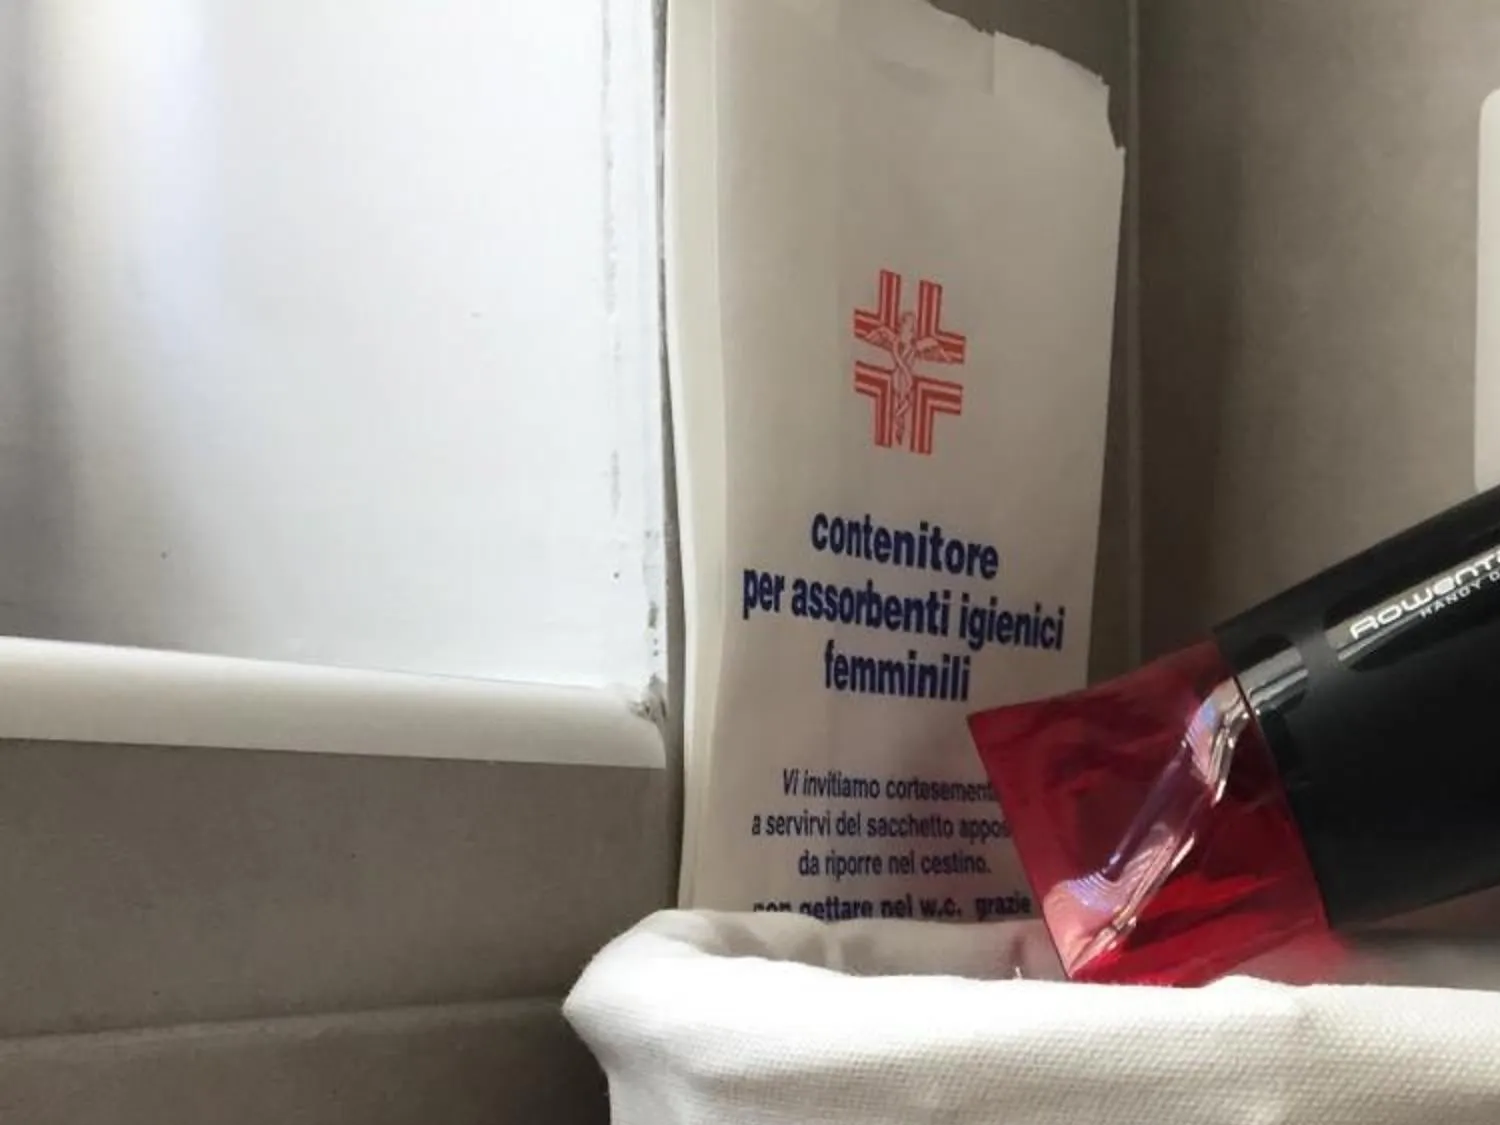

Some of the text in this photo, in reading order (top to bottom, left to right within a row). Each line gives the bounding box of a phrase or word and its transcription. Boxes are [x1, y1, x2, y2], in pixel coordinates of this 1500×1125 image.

[811, 512, 999, 580] contenitore
[743, 568, 1066, 651] per assorbenti igienici
[824, 639, 971, 701] femminili
[783, 767, 998, 802] Vi invitiamo cortesement
[751, 808, 1011, 845] a servirvi del sacchetto appos
[798, 848, 993, 882] da riporre nel cestino.
[880, 892, 913, 919] nel
[974, 890, 1032, 922] grazie
